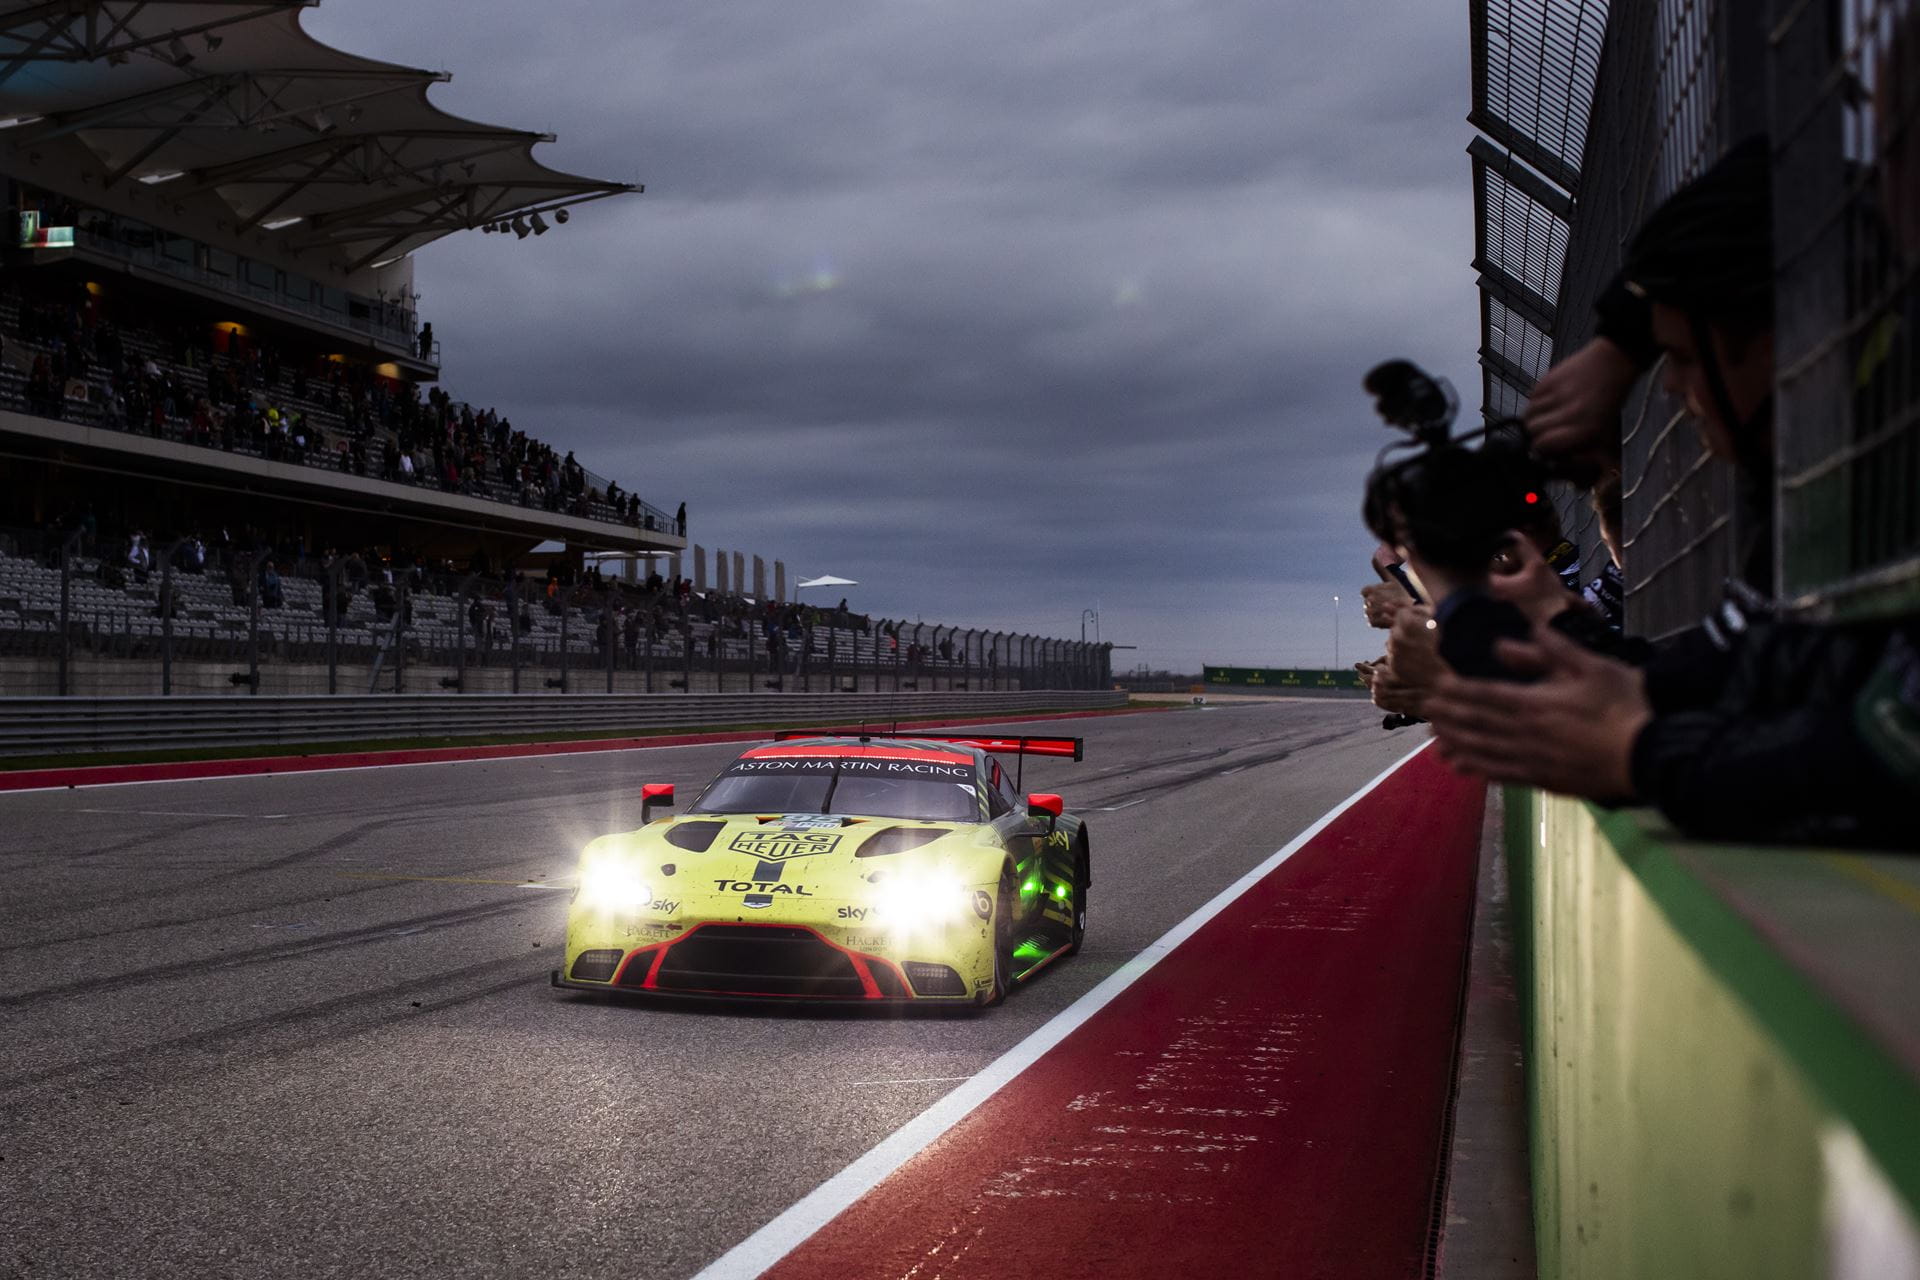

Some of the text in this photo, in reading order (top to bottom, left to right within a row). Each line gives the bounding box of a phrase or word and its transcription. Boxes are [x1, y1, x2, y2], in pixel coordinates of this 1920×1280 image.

[731, 761, 968, 777] ASTON MARTIN RACING
[749, 833, 831, 842] TAG
[737, 842, 828, 858] HEUER
[714, 880, 813, 896] TOTAL
[652, 898, 681, 914] sky
[837, 905, 868, 921] sky
